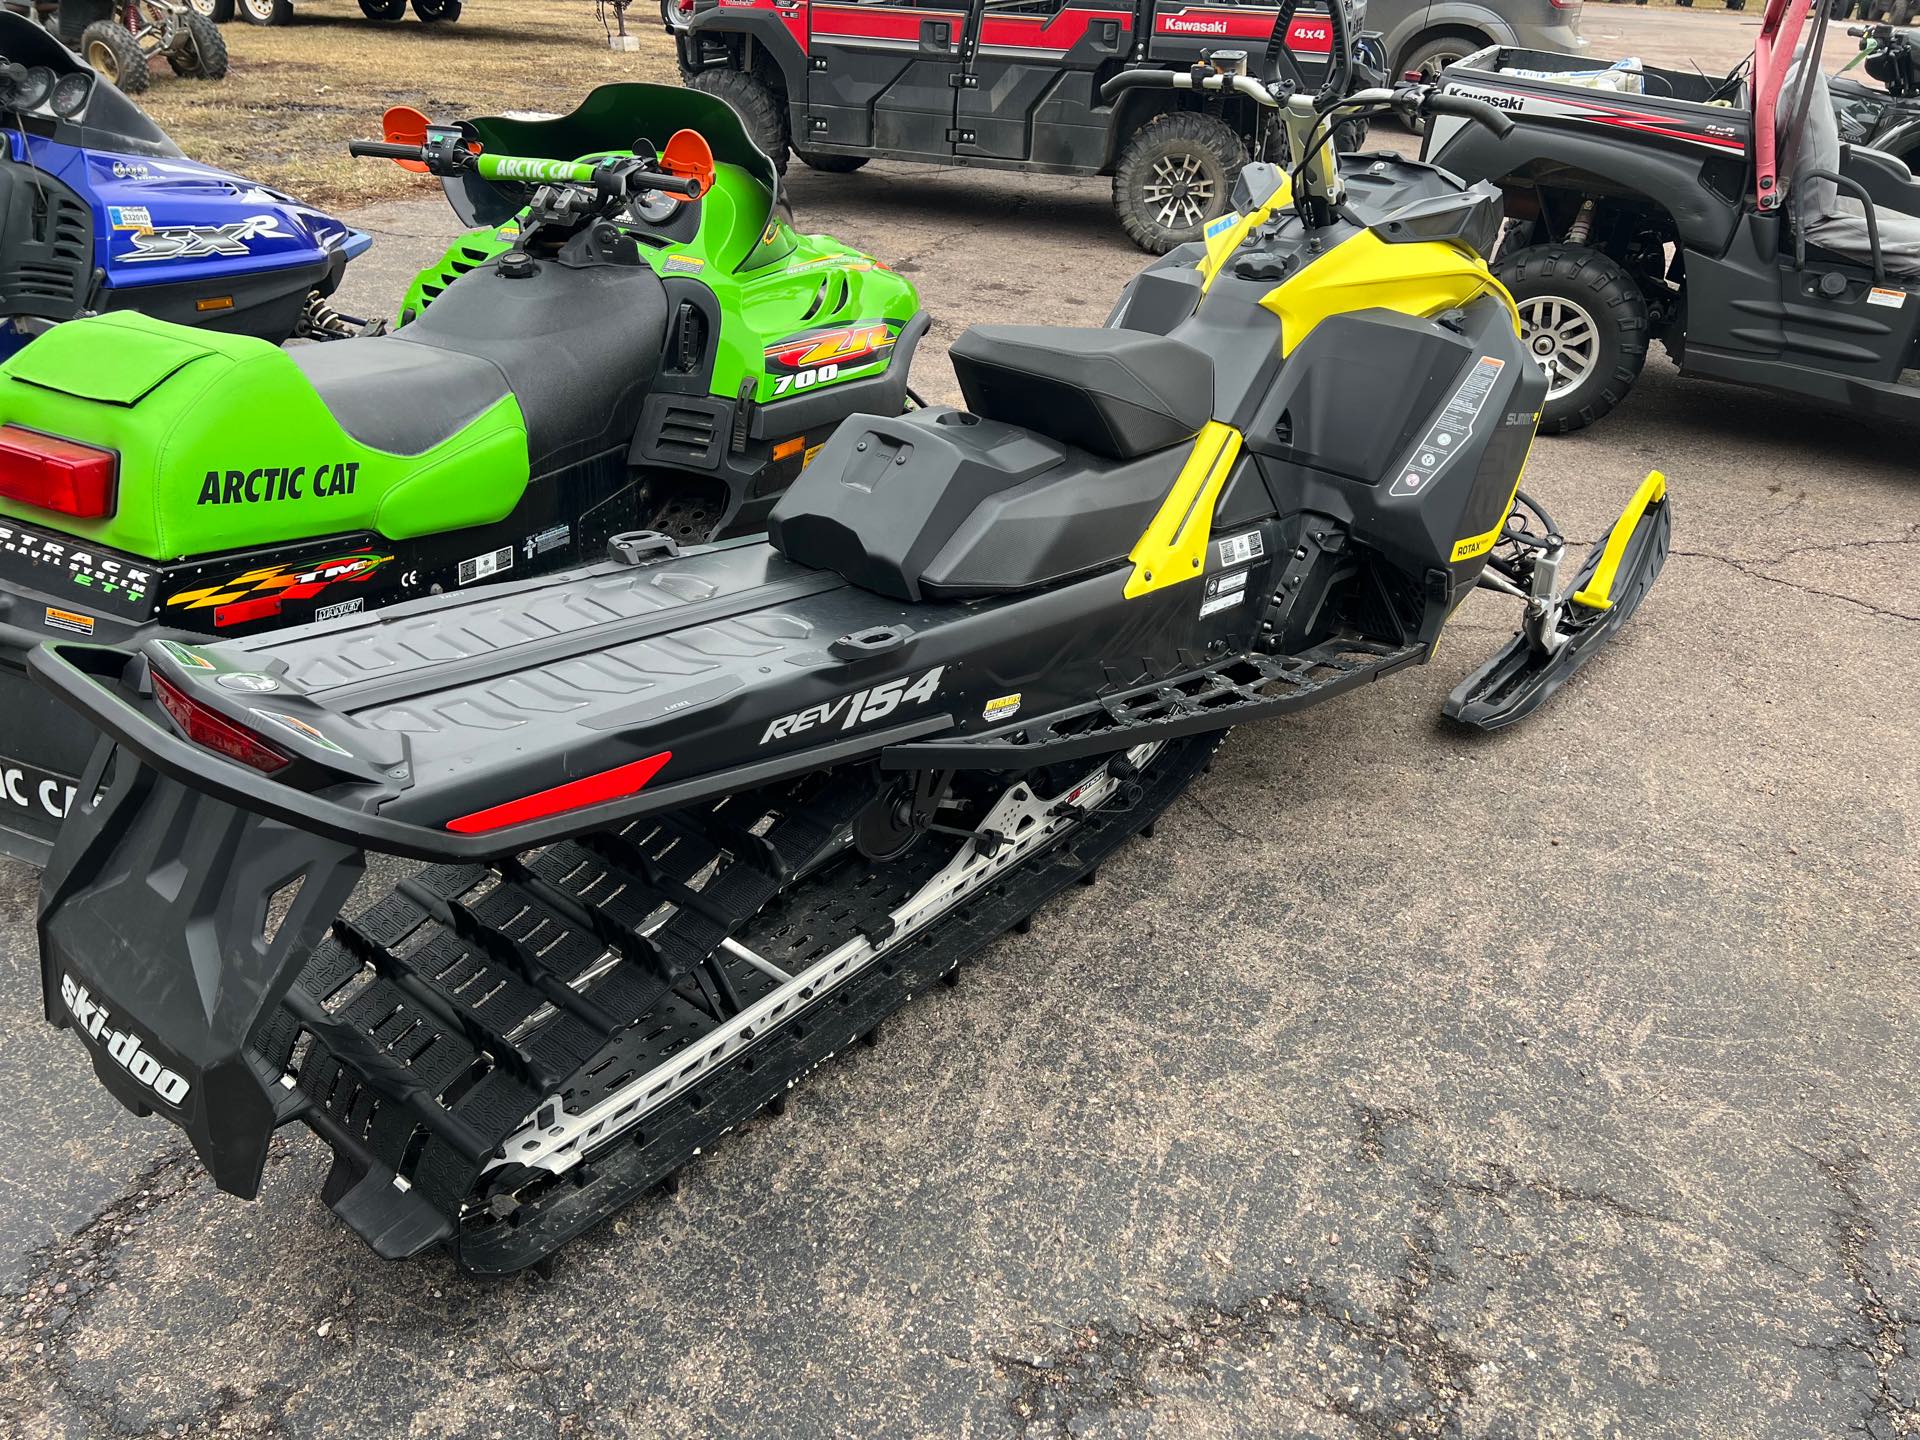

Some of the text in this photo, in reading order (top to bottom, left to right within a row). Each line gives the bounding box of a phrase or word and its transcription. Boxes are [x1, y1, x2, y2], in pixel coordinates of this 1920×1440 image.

[1165, 18, 1228, 34] Kawasaki
[1294, 28, 1326, 40] 4x4
[1838, 133, 1862, 143] ONDA
[113, 161, 148, 178] 600
[496, 159, 579, 180] ARCTIC CAT
[798, 324, 897, 367] ZR
[773, 363, 838, 396] 700
[197, 462, 359, 505] ARCTIC CAT
[1457, 541, 1481, 556] ROTAX
[0, 540, 147, 593] RAVEL SYSTEM
[73, 573, 145, 602] ETT
[401, 569, 418, 588] CE
[318, 600, 362, 621] MANLEY
[841, 665, 946, 731] 154
[61, 973, 190, 1105] ski-doo
